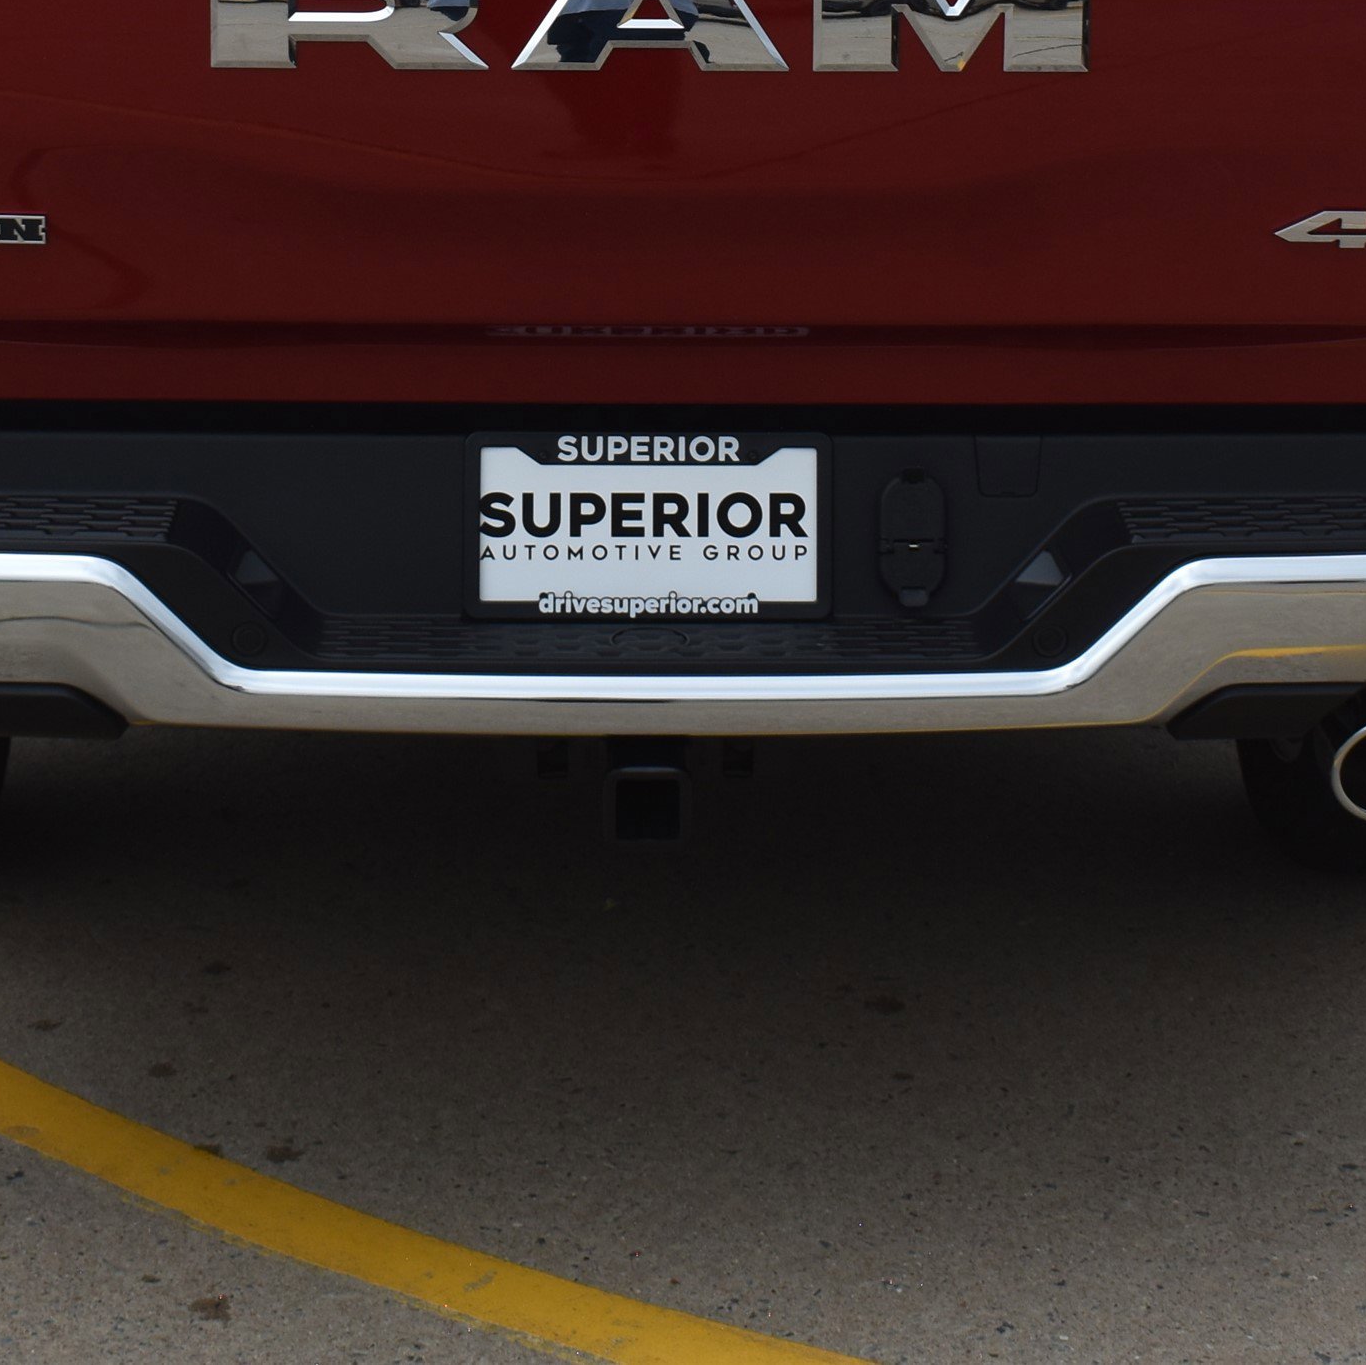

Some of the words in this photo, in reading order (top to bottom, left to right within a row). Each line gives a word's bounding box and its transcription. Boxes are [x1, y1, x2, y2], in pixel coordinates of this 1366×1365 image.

[557, 436, 740, 463] SUPERIOR
[479, 491, 809, 538] SUPERIOR
[480, 544, 682, 561] AUTOMOTIVE
[702, 544, 808, 561] GROUP
[538, 592, 759, 618] drivesuperior.com
